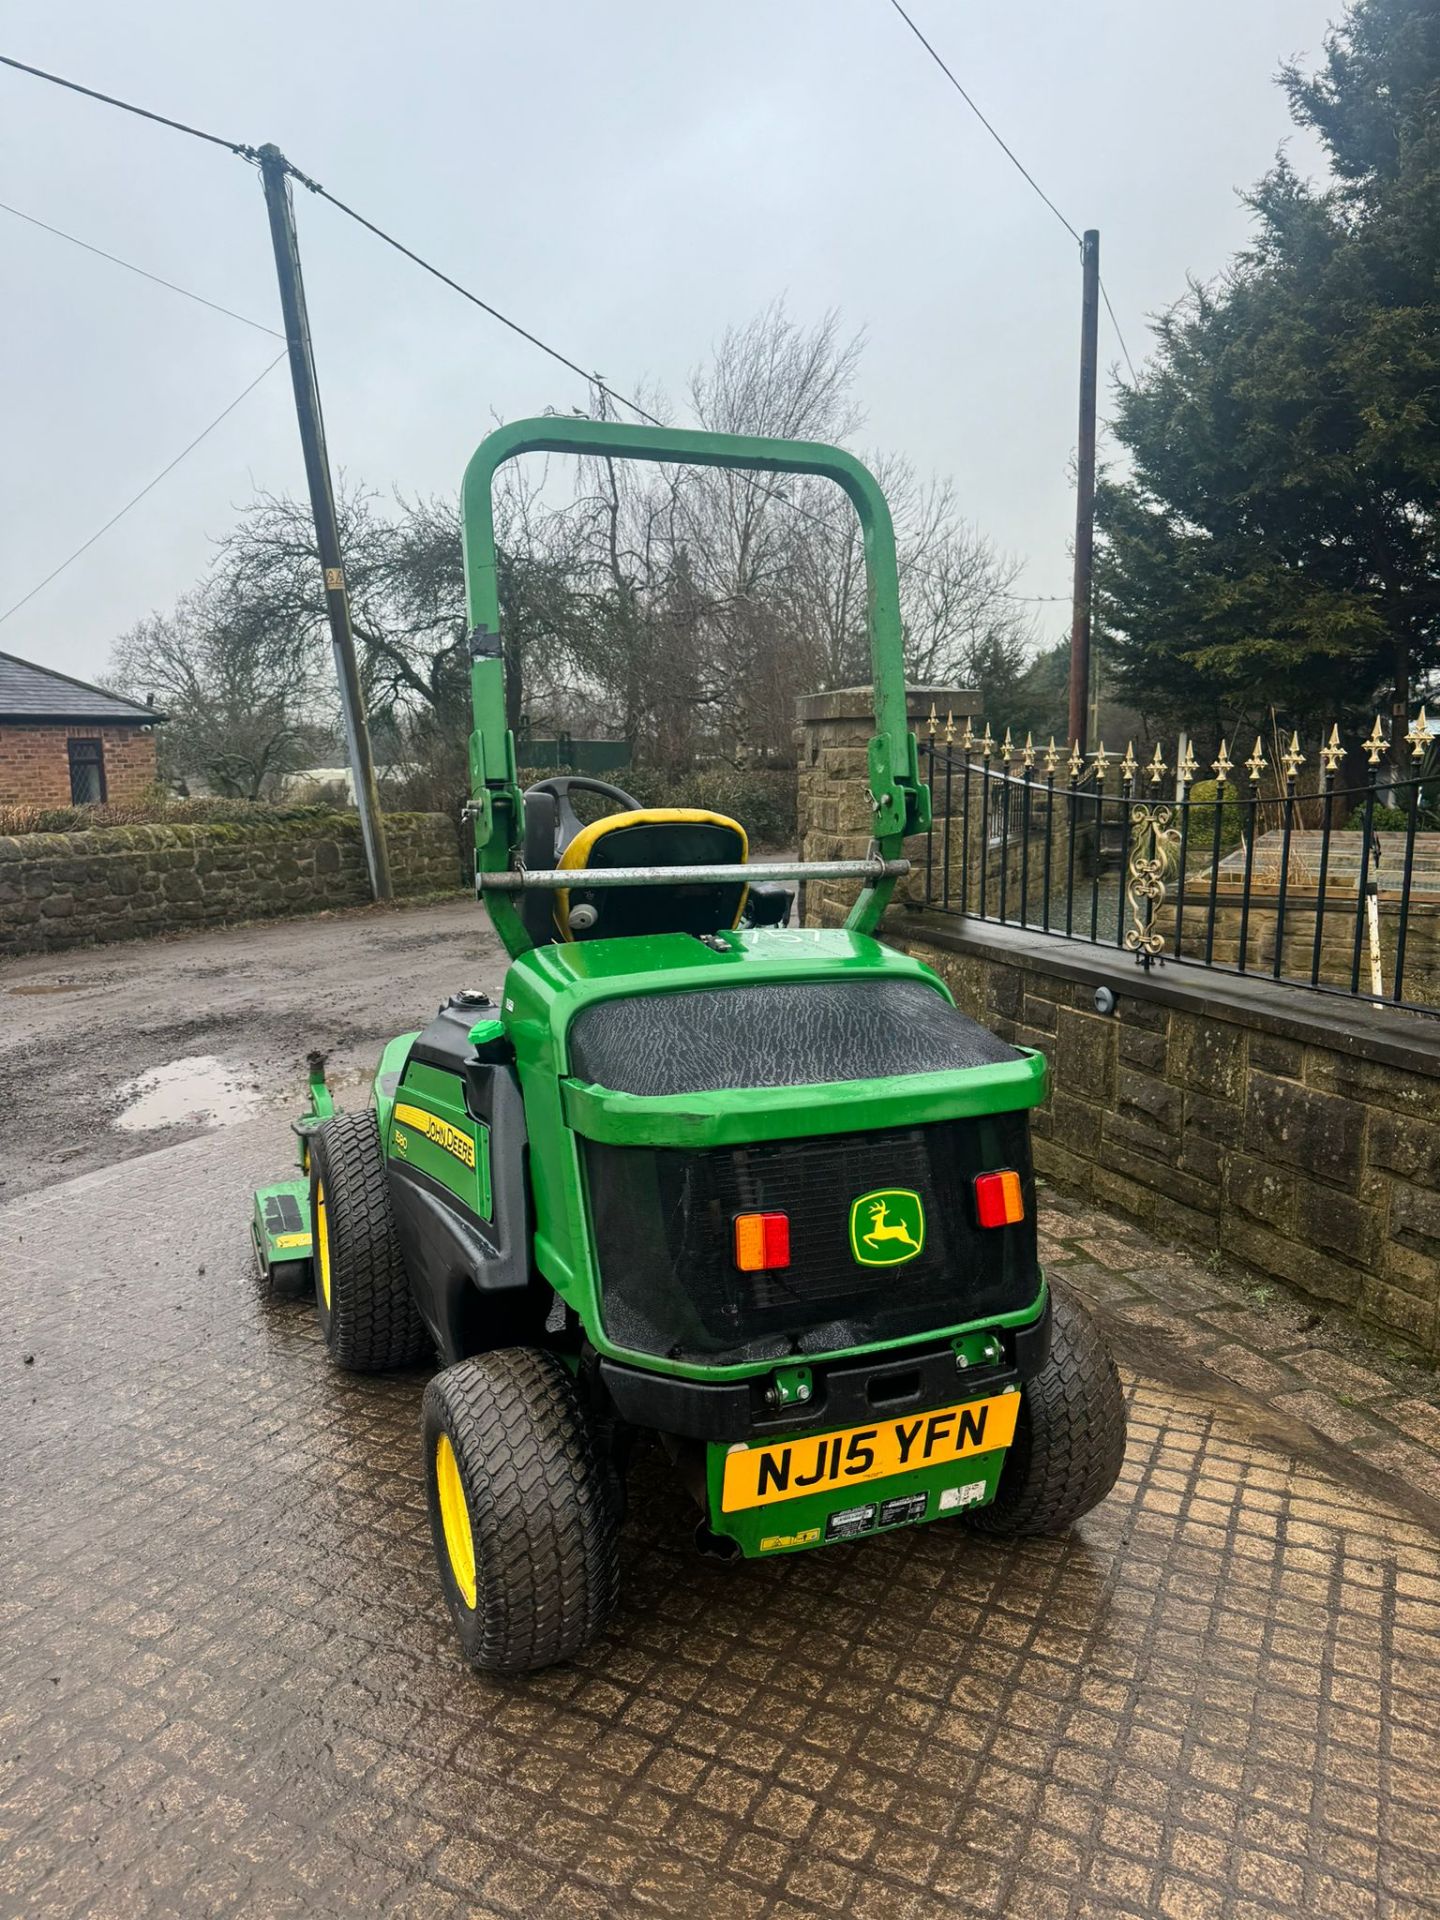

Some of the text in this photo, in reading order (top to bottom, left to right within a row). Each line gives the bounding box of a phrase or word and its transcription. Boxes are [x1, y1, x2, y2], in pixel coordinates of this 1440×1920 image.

[425, 1116, 474, 1165] JOHN DEERE
[757, 1405, 989, 1496] NJ15 YFN
